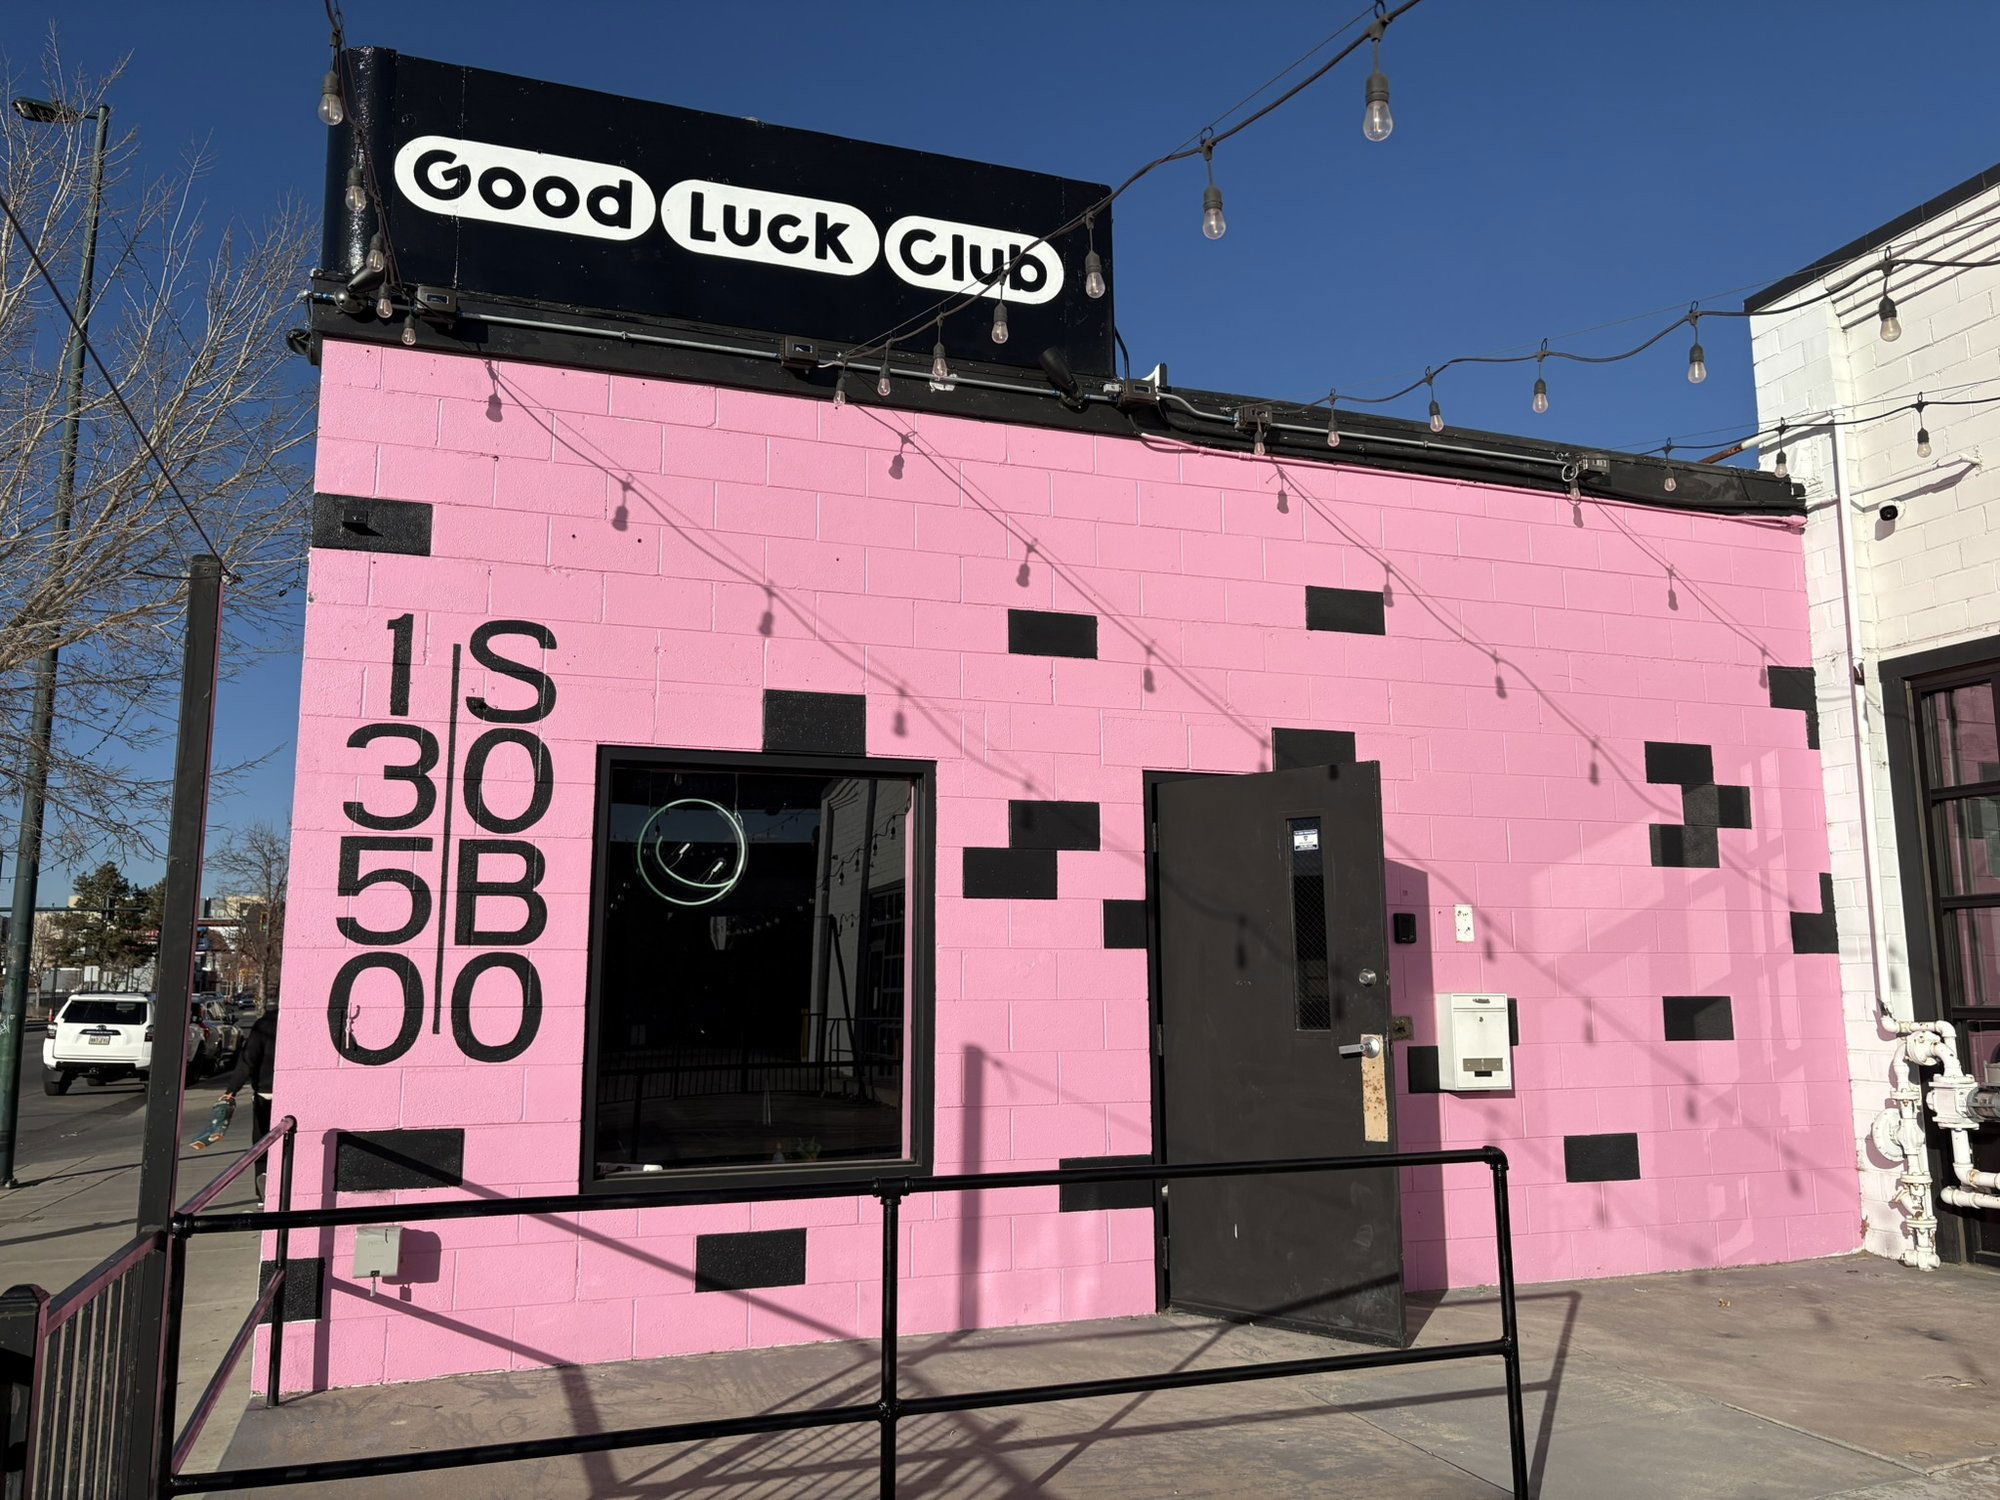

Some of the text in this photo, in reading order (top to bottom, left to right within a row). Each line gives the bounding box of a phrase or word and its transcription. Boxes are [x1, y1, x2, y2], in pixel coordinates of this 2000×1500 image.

[413, 149, 1048, 293] Good Luck Club
